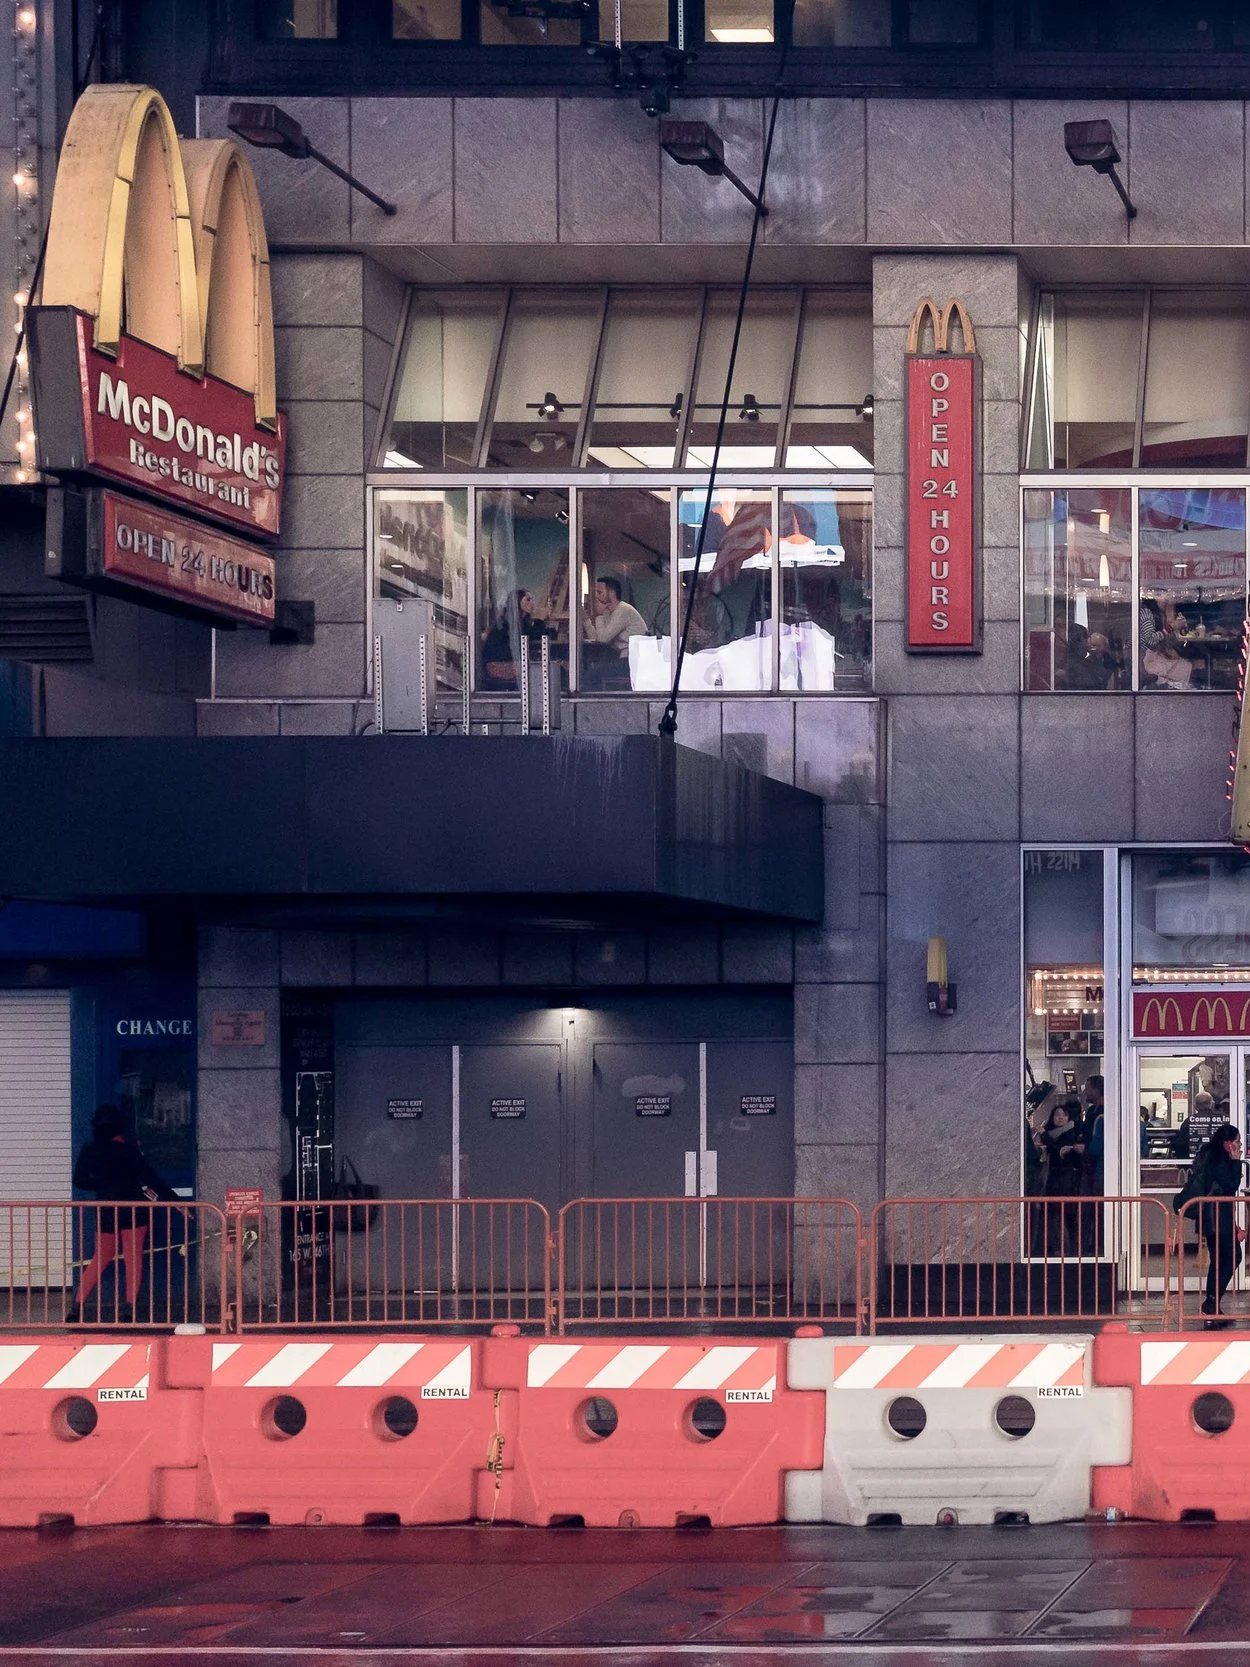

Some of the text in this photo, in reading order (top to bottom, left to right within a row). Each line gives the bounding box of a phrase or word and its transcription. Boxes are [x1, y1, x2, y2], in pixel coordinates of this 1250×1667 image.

[930, 372, 950, 468] OPEN
[97, 371, 280, 490] McDonald's
[129, 437, 253, 511] Restaurant
[922, 480, 958, 500] 24
[116, 522, 274, 601] OPEN 24 HOURS
[930, 509, 950, 632] HOURS
[116, 1019, 193, 1036] CHANGE
[99, 1389, 145, 1400] RENTAL
[423, 1388, 467, 1397] RENTAL
[727, 1391, 770, 1400] RENTAL
[1038, 1387, 1082, 1397] RENTAL
